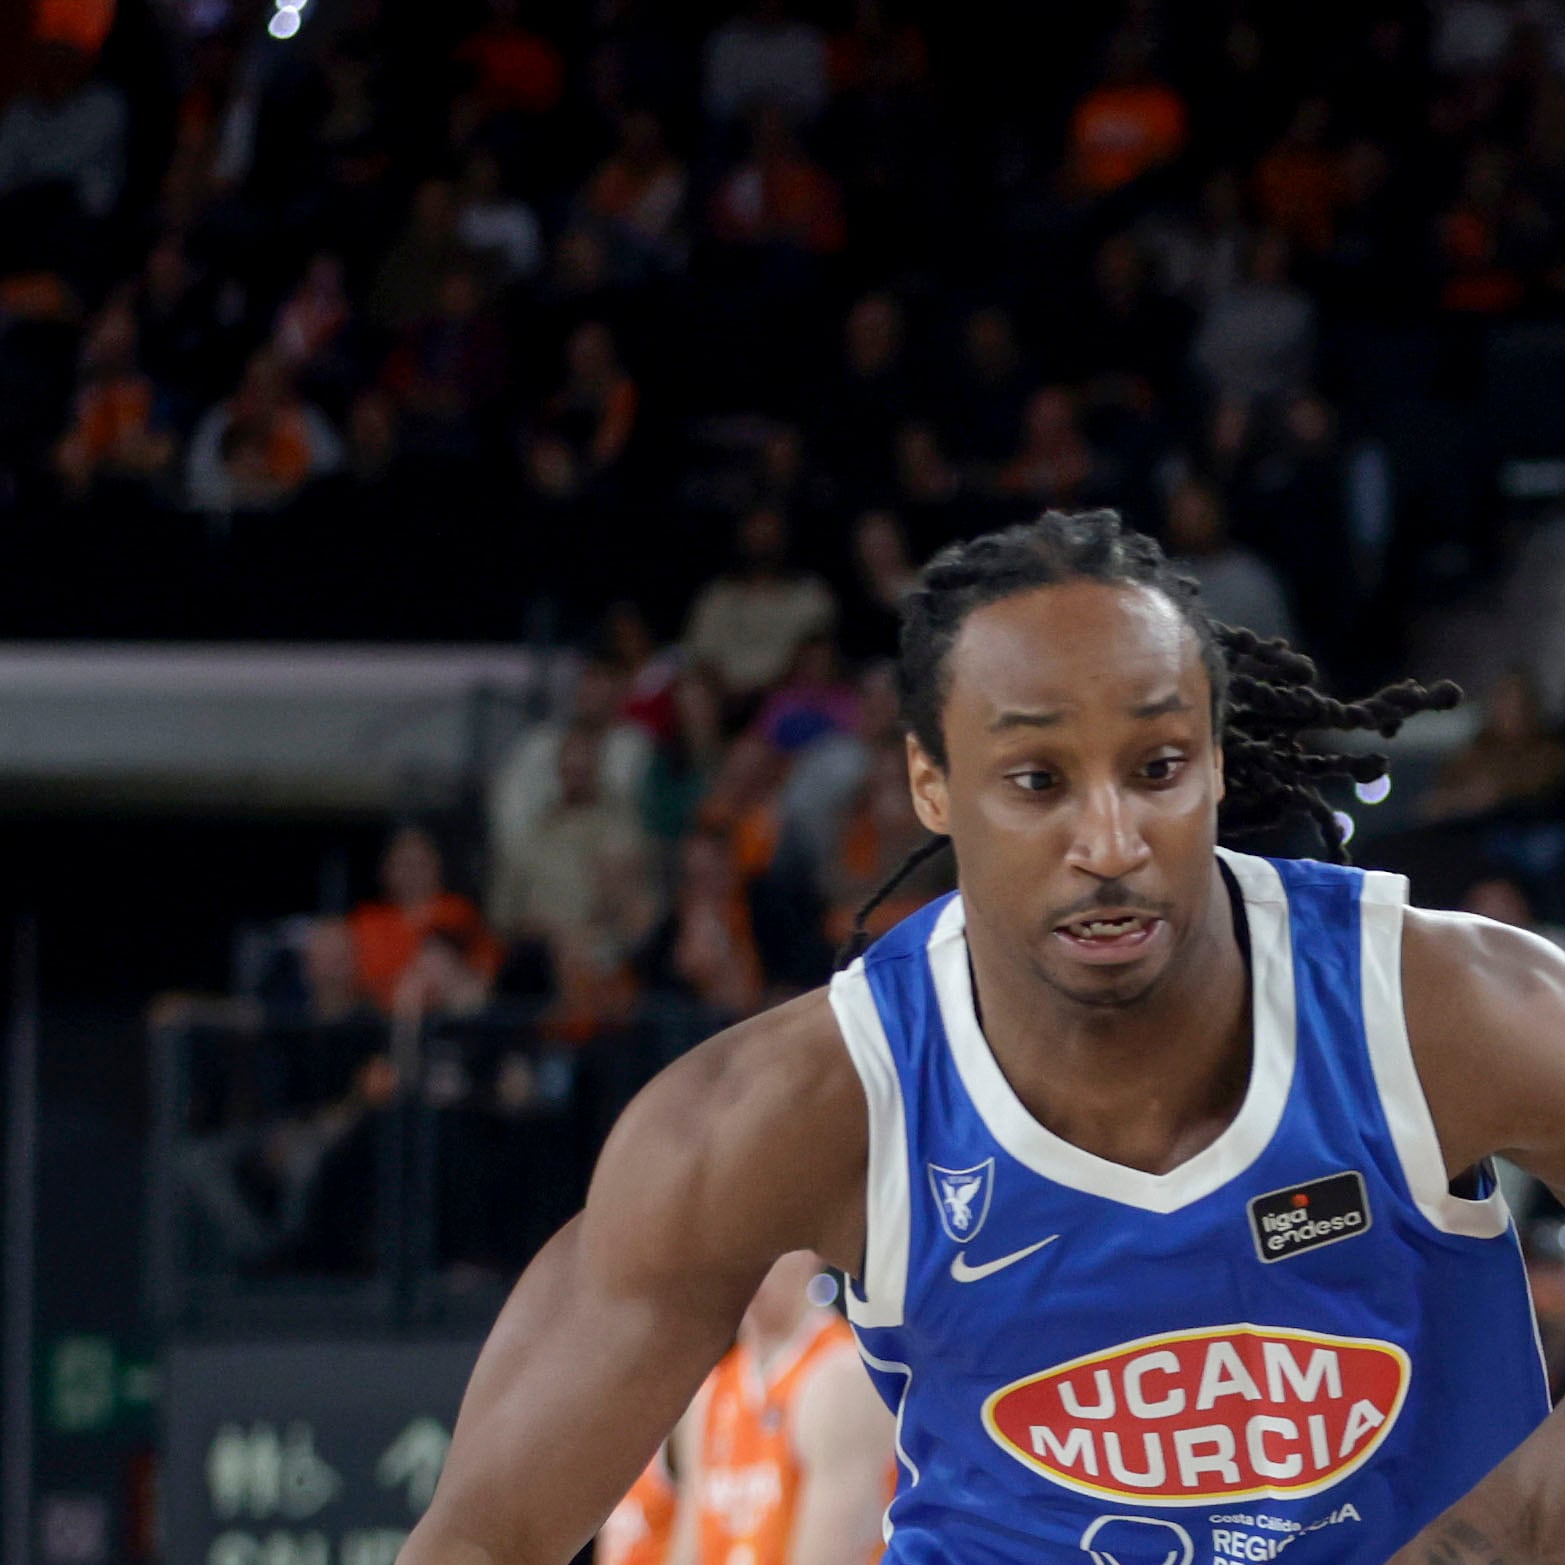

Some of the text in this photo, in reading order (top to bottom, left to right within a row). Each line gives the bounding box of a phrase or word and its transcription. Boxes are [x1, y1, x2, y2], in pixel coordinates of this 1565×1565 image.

[1262, 1208, 1308, 1233] liga
[1267, 1211, 1362, 1250] endesa
[1057, 1341, 1343, 1420] UCAM
[1029, 1399, 1387, 1488] MURCIA
